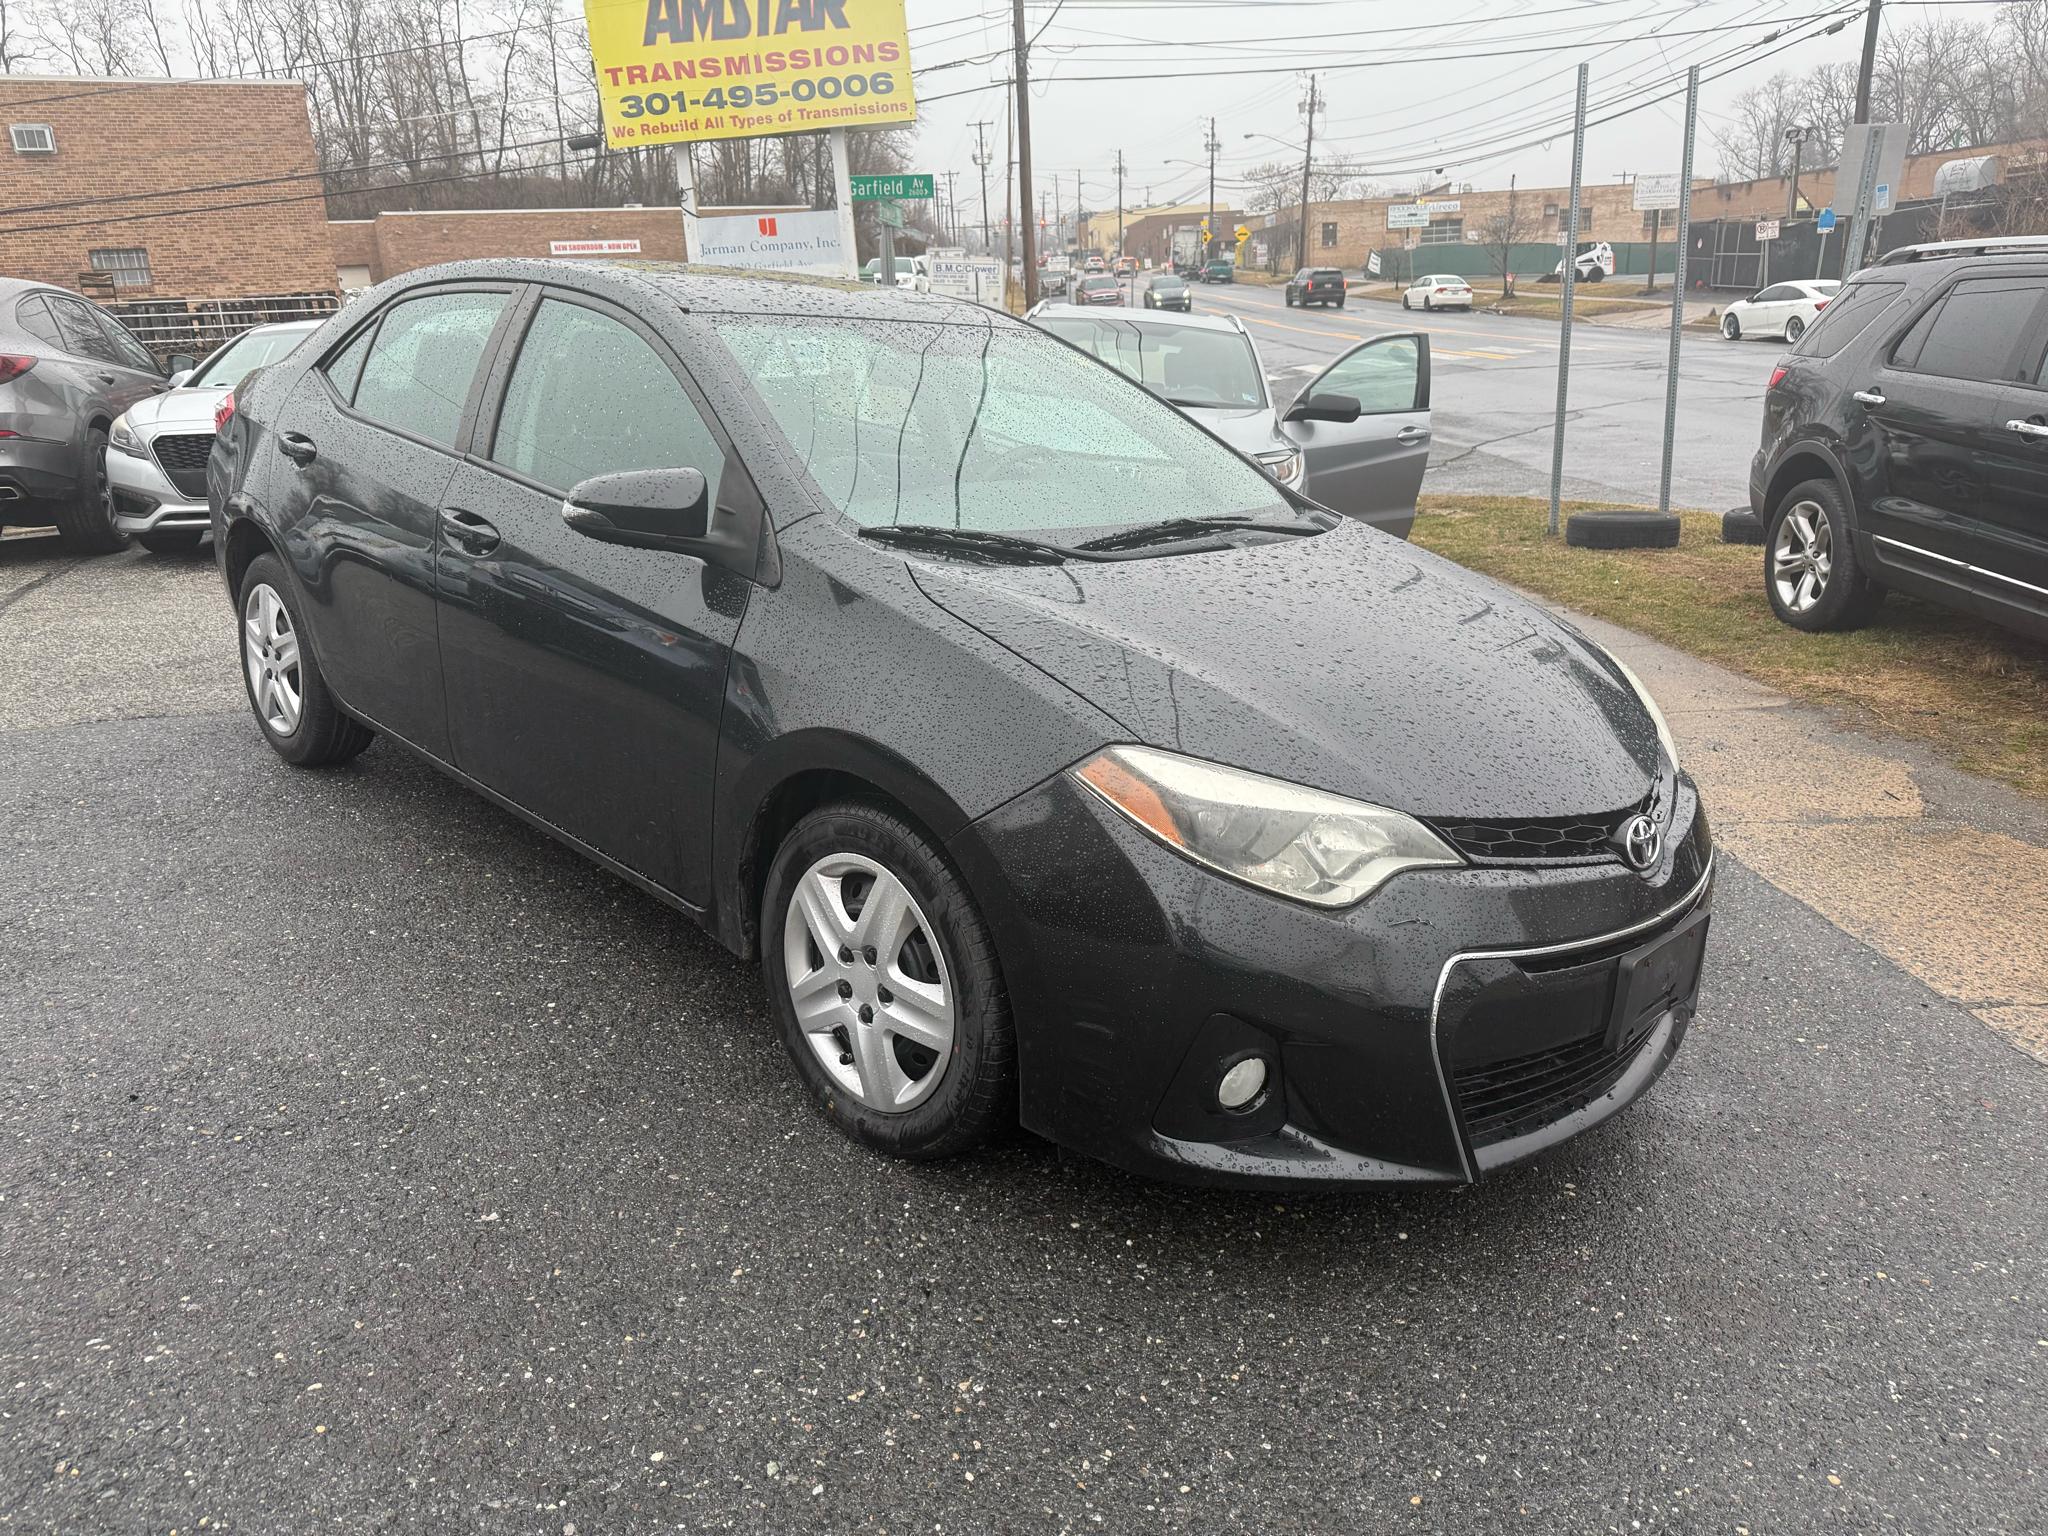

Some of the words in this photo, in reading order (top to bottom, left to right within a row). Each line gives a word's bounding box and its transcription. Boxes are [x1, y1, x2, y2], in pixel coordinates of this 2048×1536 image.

[605, 42, 900, 86] TRANSMISSIONS
[619, 72, 894, 118] 301-495-0006
[612, 126, 635, 138] We
[640, 119, 699, 136] Rebuild
[704, 116, 724, 130] All
[729, 113, 773, 129] Types
[778, 109, 792, 123] of
[797, 102, 908, 121] Transmissions
[849, 180, 903, 196] Garfield
[912, 178, 924, 188] Av
[700, 243, 745, 257] Jarman
[750, 239, 813, 253] Company,
[816, 236, 840, 249] Inc.
